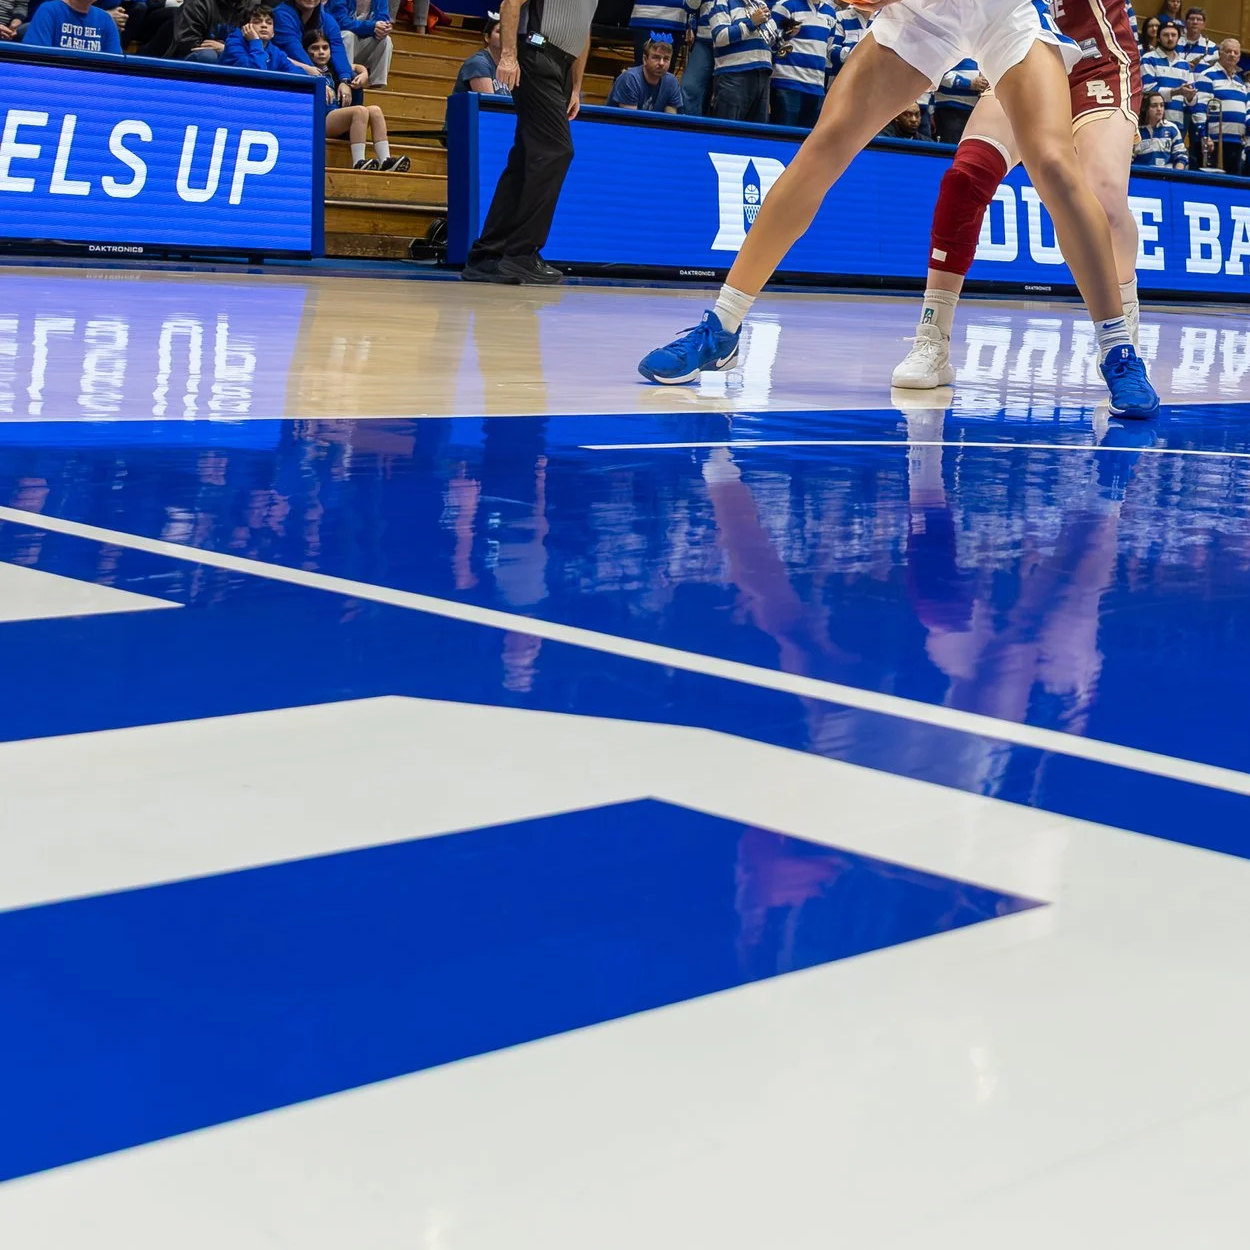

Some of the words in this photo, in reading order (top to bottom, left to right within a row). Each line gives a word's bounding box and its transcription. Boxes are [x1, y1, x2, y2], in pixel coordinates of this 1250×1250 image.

[73, 26, 83, 37] TO
[0, 109, 153, 199] ELS
[176, 124, 280, 205] UP
[974, 183, 1165, 271] DUE
[89, 244, 144, 254] DAKTRONICS
[680, 269, 716, 277] DAKTRONICS
